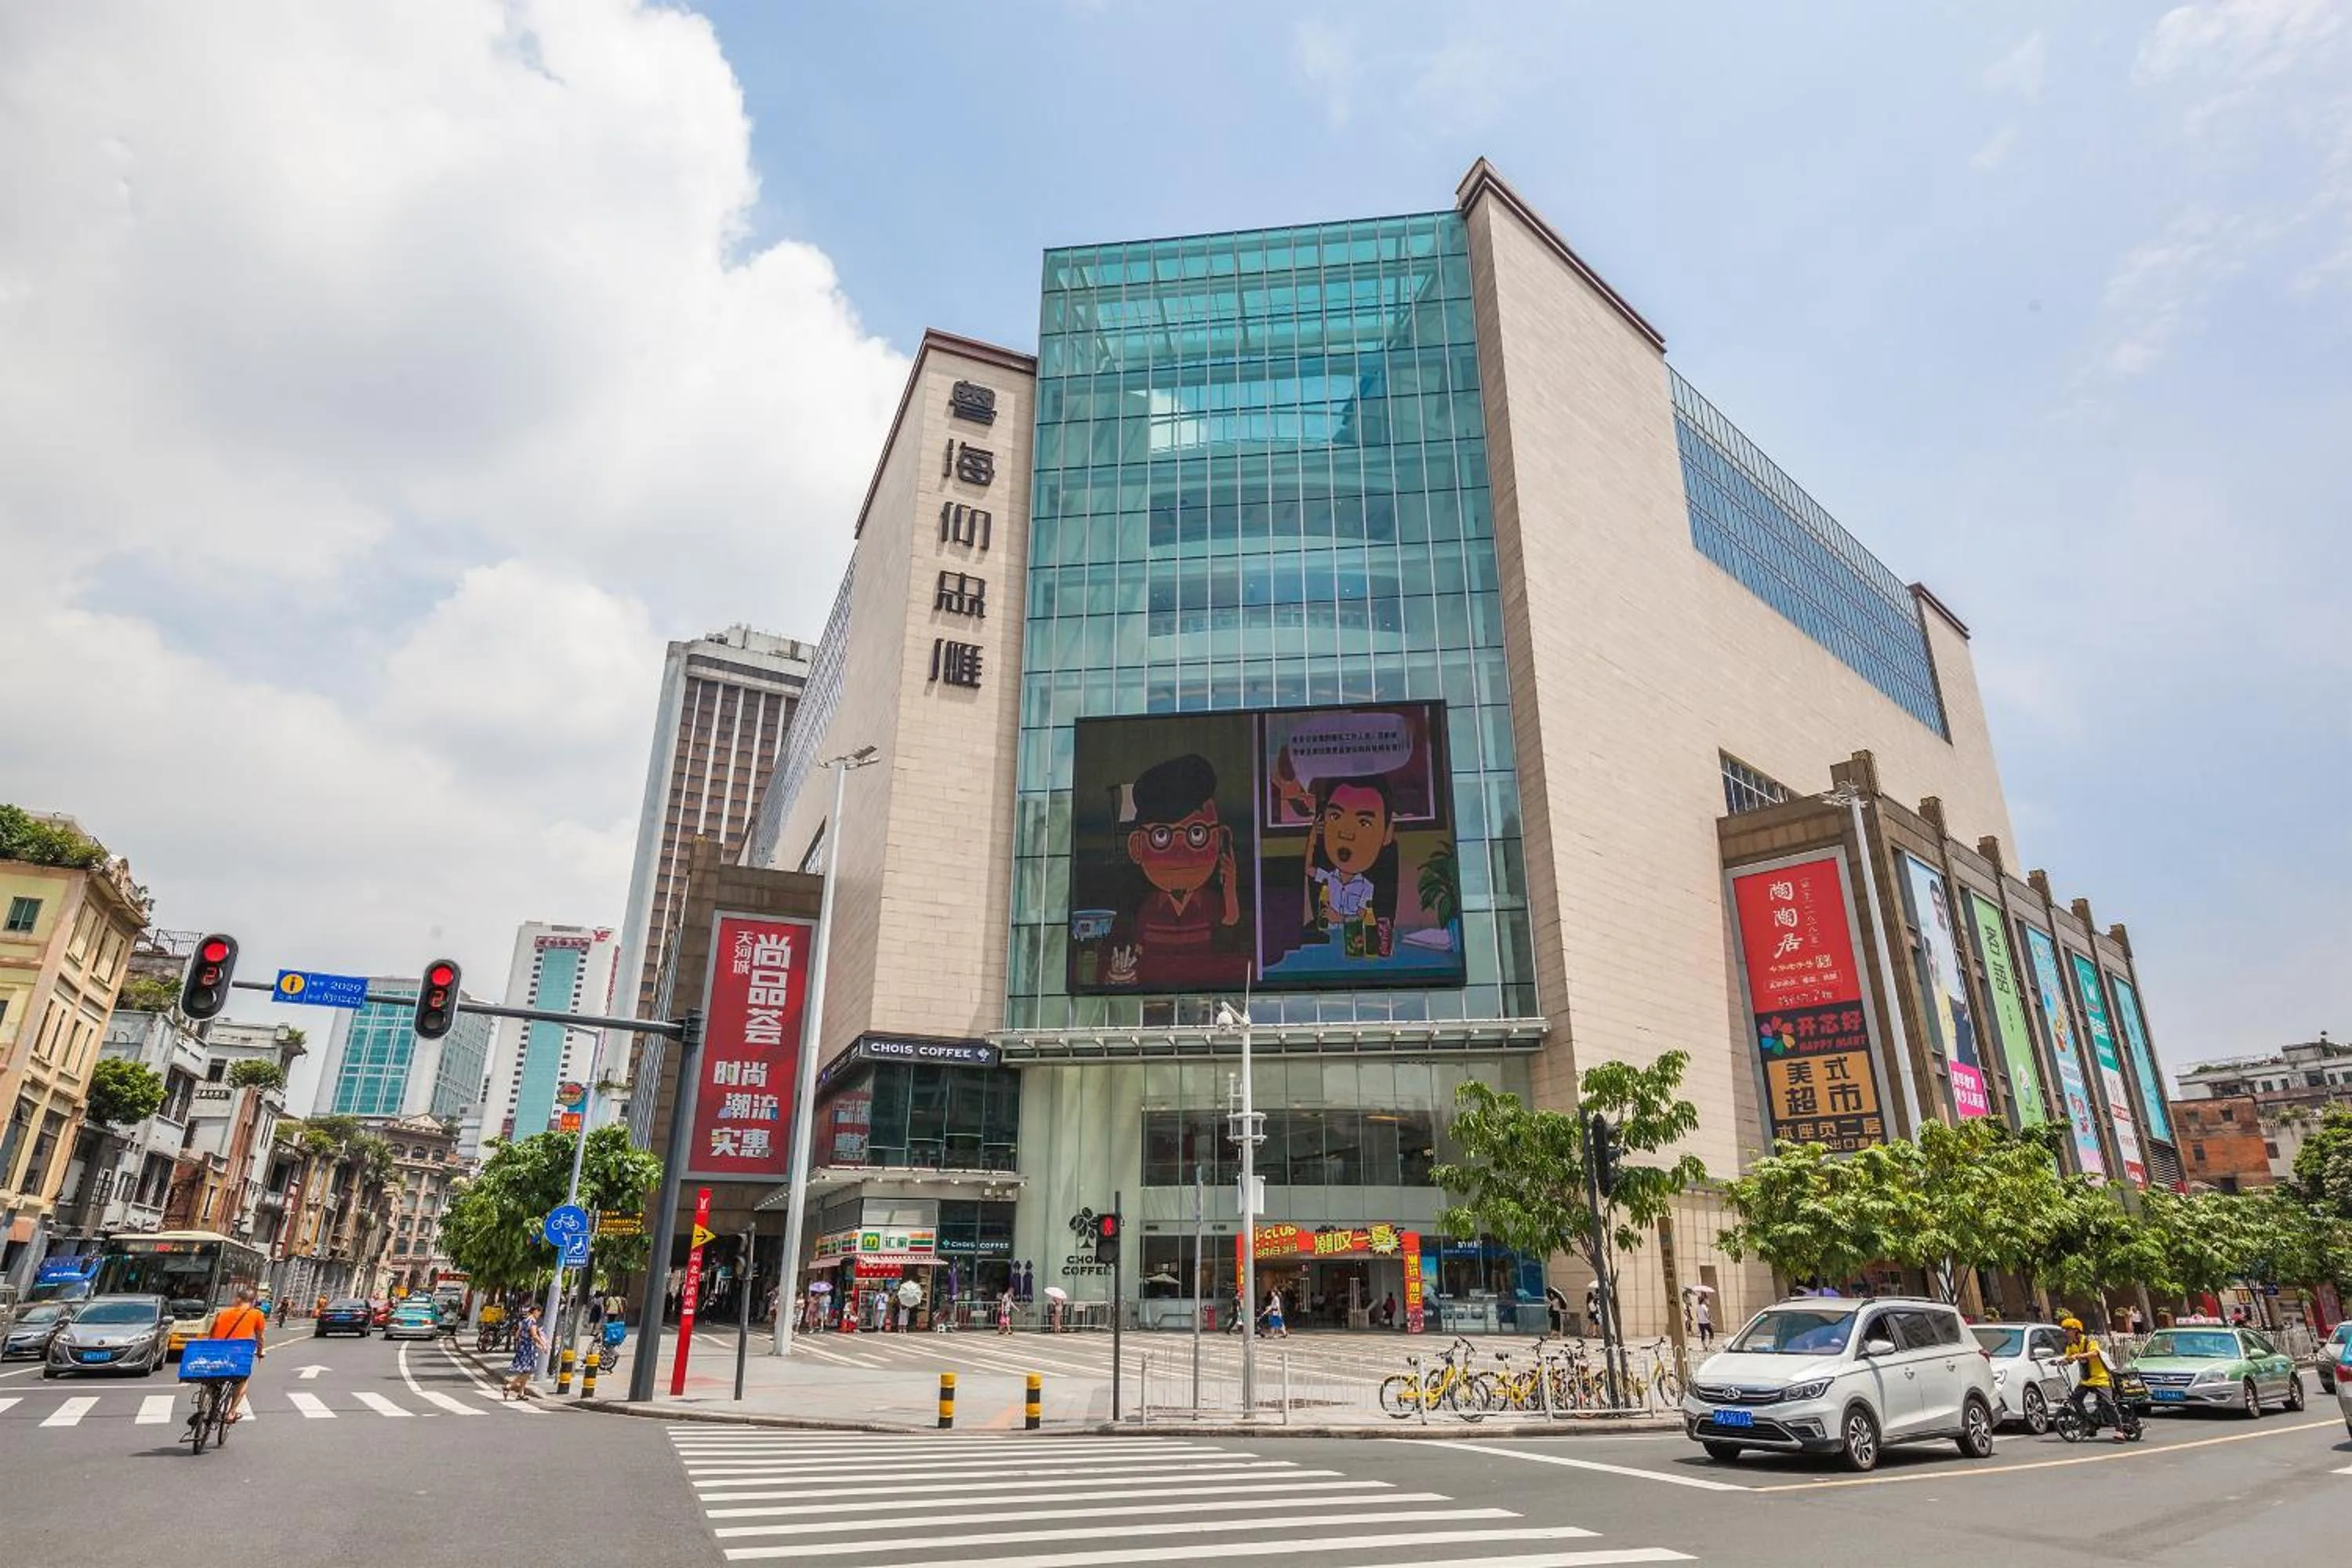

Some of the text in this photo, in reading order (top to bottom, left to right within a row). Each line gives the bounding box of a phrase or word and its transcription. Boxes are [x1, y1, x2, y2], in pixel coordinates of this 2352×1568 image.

[1768, 880, 1804, 960] 陶陶居
[732, 930, 753, 975] 天河城
[330, 981, 362, 993] 2029
[745, 934, 790, 1046] 尚品荟
[870, 1042, 971, 1059] CHOIS COFFEE
[1799, 1034, 1867, 1053] HAPPY MART
[713, 1061, 768, 1088] 时尚
[1786, 1056, 1852, 1086] 美式
[723, 1093, 779, 1121] 潮流
[1784, 1083, 1864, 1117] 超市
[710, 1127, 771, 1159] 实惠
[1062, 1265, 1112, 1276] COFFEE
